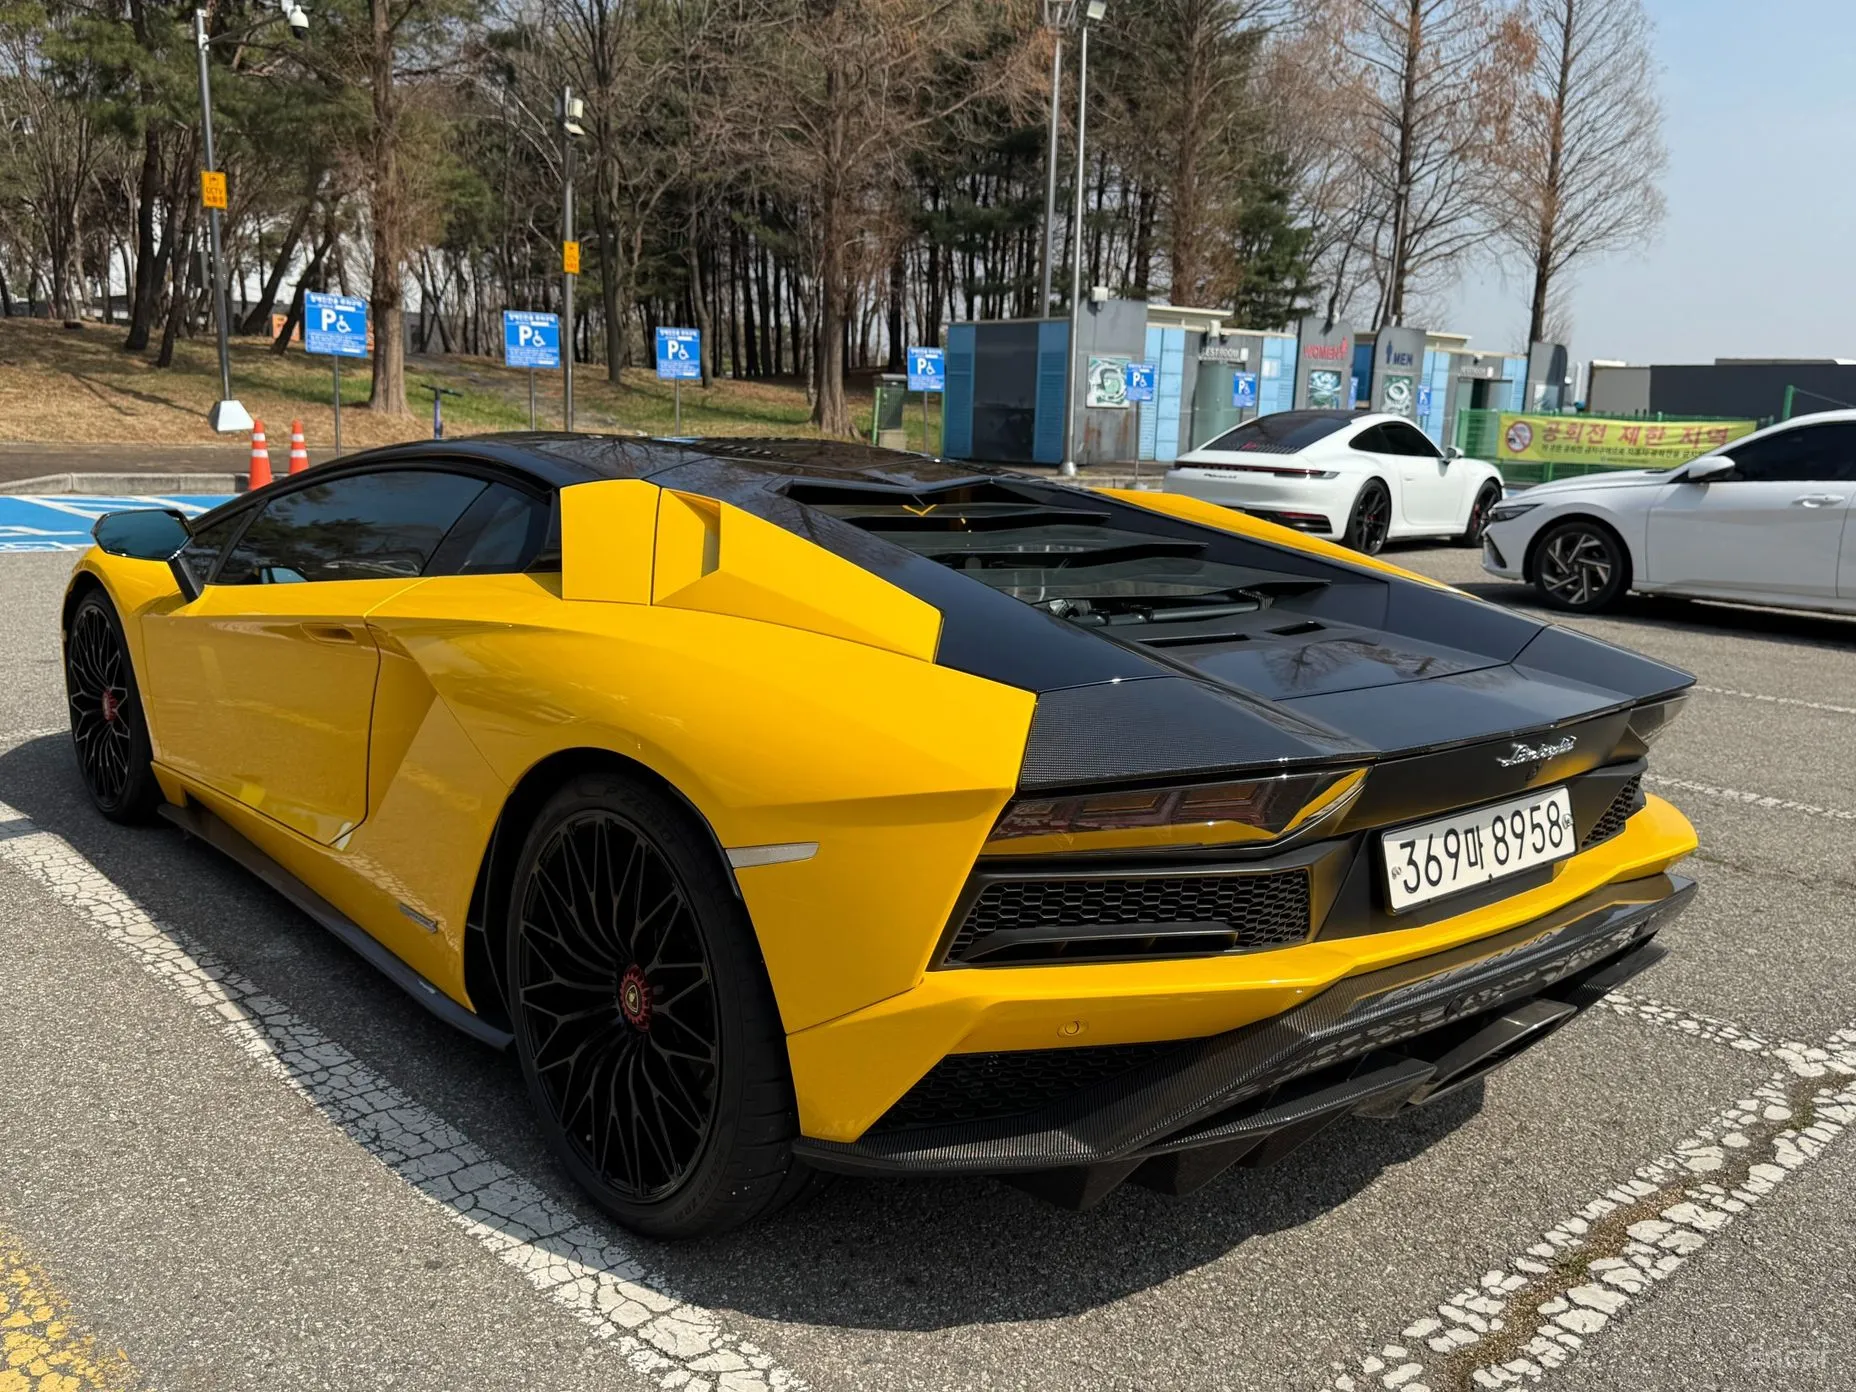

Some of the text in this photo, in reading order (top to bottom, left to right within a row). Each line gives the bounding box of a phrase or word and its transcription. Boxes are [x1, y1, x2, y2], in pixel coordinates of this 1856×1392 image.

[321, 308, 337, 332] P
[518, 325, 533, 347] P
[667, 339, 679, 360] P
[1394, 352, 1413, 366] MEN
[917, 357, 927, 375] P
[1133, 371, 1141, 387] P
[1542, 420, 1729, 450] 공회전 제한 지역
[1399, 800, 1564, 894] 369마 8958
